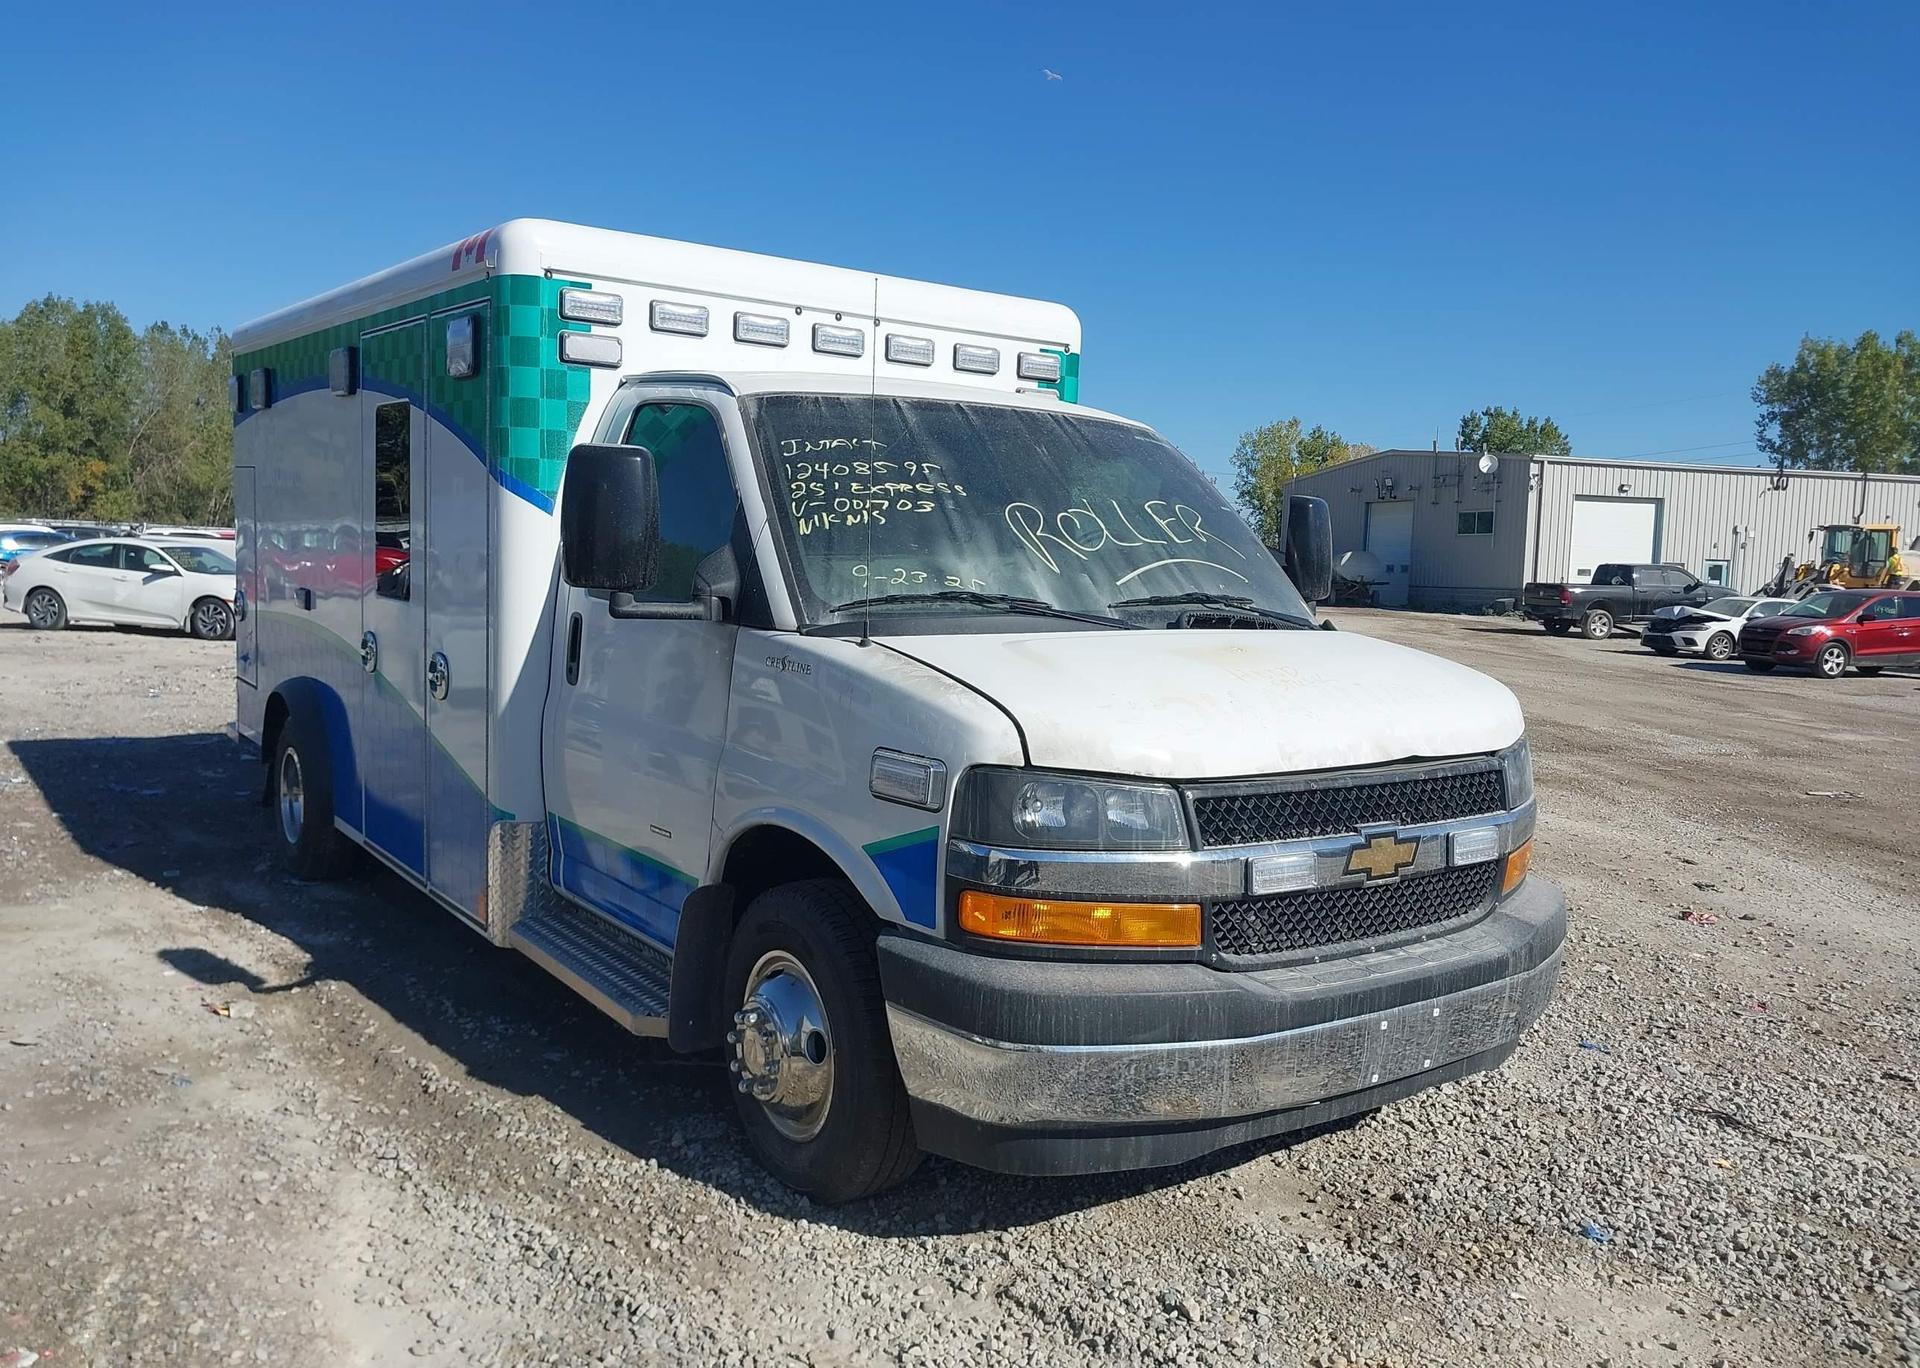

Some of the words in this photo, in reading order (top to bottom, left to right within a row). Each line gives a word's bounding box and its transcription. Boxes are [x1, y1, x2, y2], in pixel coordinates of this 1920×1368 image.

[850, 482, 967, 497] EXPRESS
[1004, 498, 1247, 575] ROLLER
[765, 655, 812, 675] CRESTLINE
